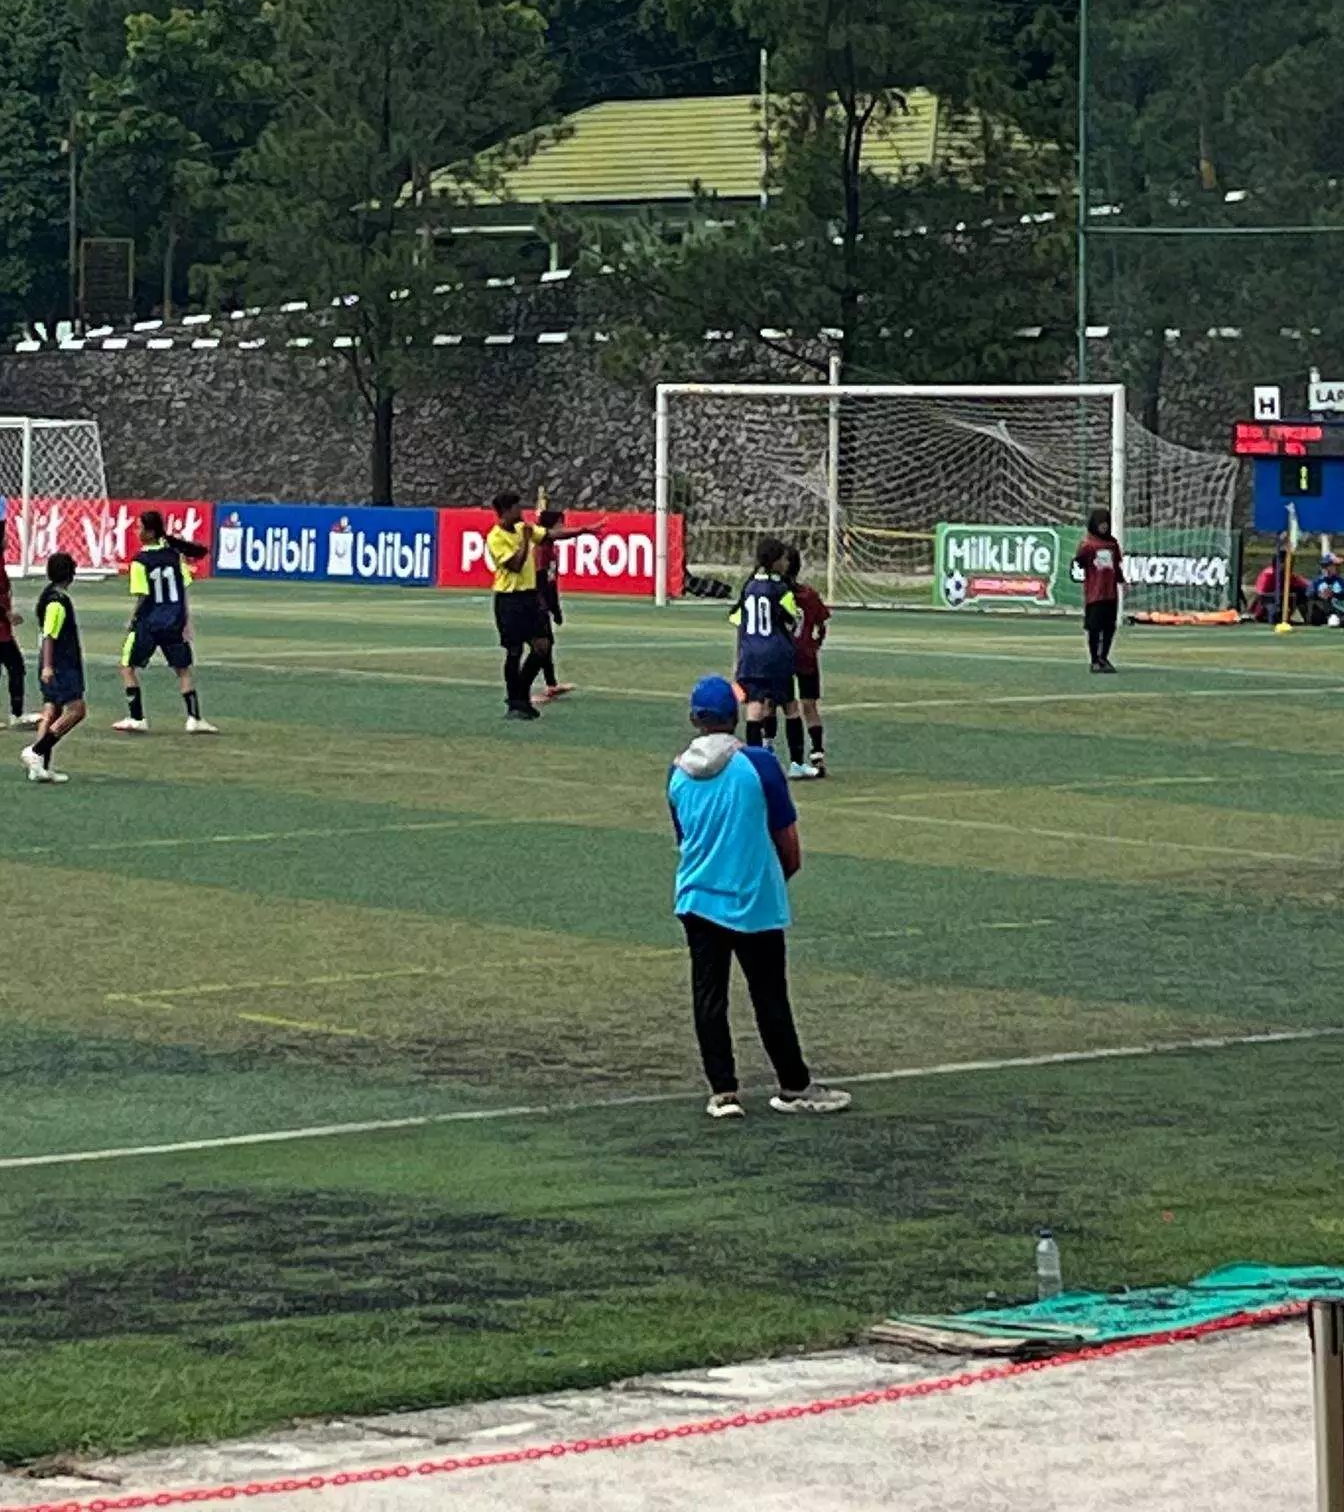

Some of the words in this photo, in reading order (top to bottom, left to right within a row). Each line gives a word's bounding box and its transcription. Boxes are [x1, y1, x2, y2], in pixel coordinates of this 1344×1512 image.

[1259, 397, 1276, 414] H
[1299, 465, 1309, 491] 1
[246, 526, 317, 572] blibli
[357, 531, 431, 578] blibli
[948, 535, 1052, 573] MilkLife
[149, 566, 179, 604] 11
[744, 595, 772, 637] 10
